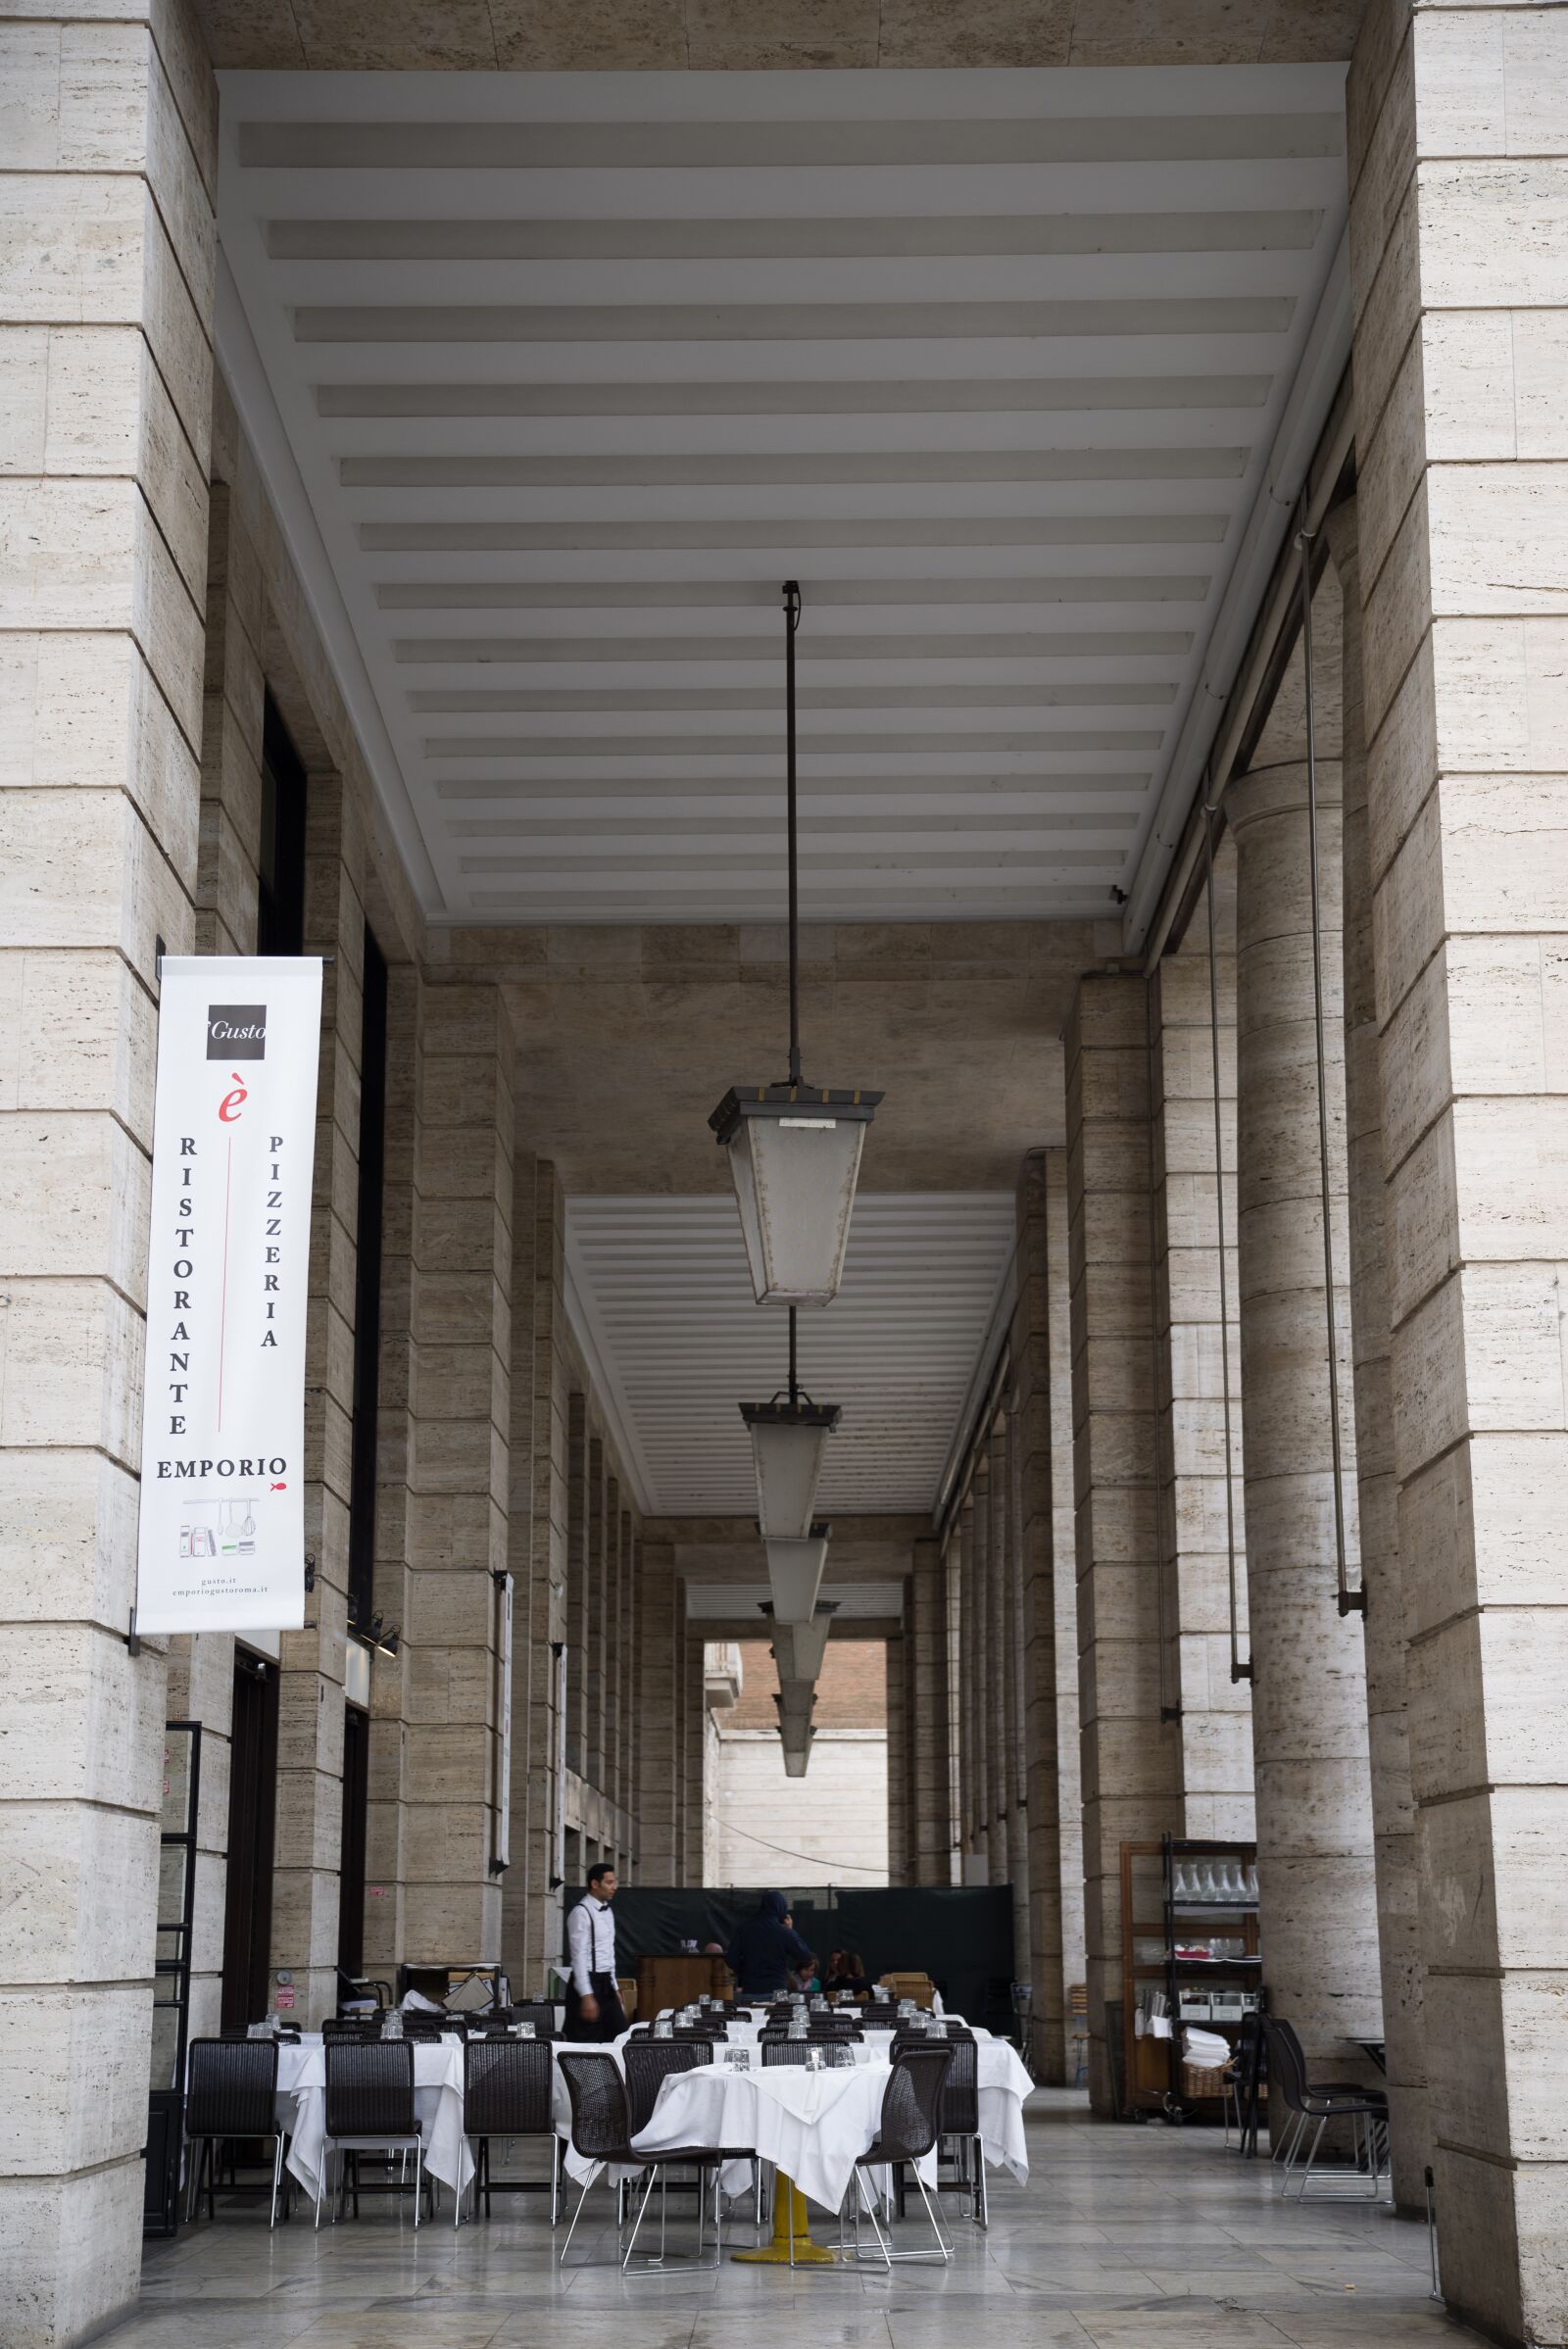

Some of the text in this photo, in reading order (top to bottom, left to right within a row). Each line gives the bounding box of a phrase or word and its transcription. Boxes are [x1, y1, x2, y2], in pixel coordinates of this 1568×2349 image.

[218, 1072, 248, 1123] è
[260, 1136, 284, 1347] PIZZERIA
[169, 1137, 198, 1435] RISTORANTE
[156, 1457, 287, 1479] EMPORIO
[172, 1587, 268, 1597] emporiogustoroma.it
